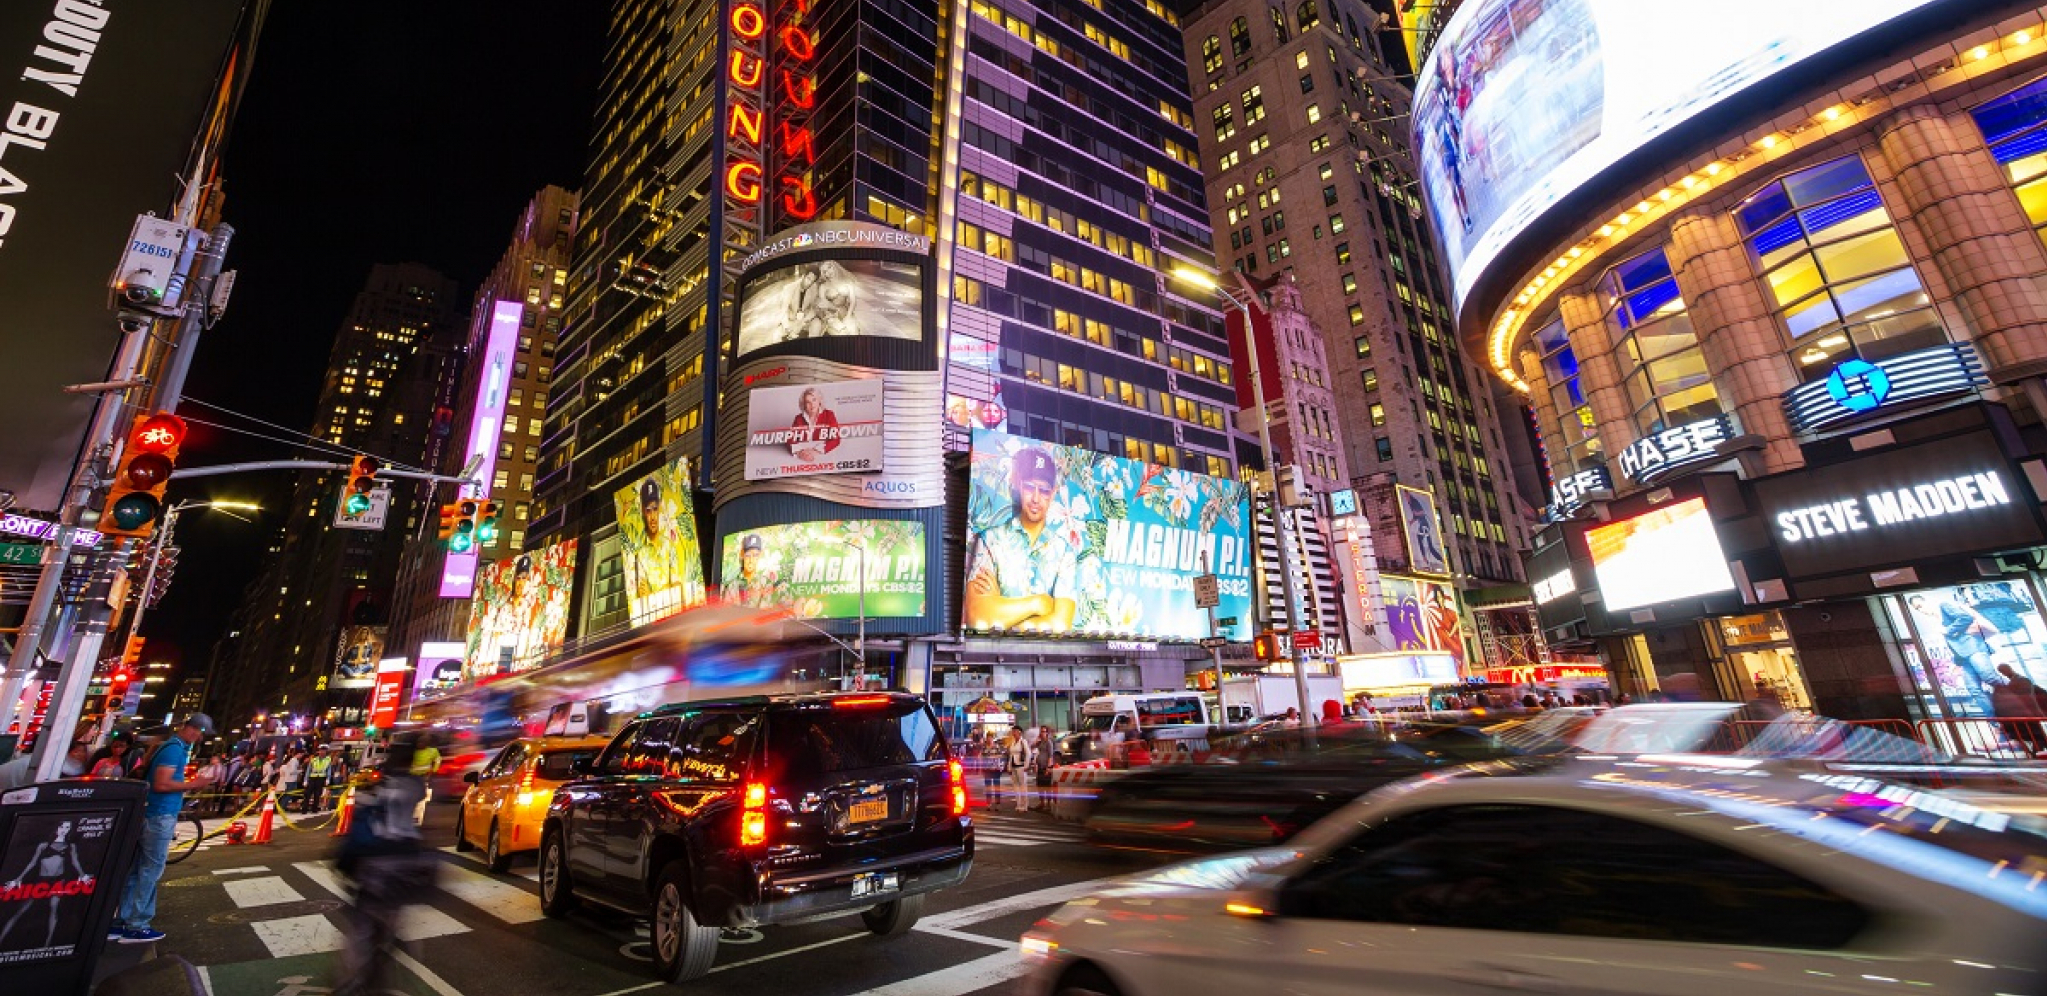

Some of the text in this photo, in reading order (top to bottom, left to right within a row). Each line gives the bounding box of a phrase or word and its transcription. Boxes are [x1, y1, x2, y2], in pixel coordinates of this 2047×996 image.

[132, 240, 173, 259] 726151
[815, 230, 930, 250] NBCUNIVERSAL
[750, 428, 814, 447] MURPHY
[818, 424, 879, 441] BROWN
[1618, 417, 1727, 479] CHASE
[755, 467, 779, 476] NEW
[780, 462, 835, 474] THURSDAYS
[864, 481, 916, 493] AQUOS
[1778, 470, 2010, 542] STEVE MADDEN
[3, 546, 25, 561] 42
[1103, 517, 1250, 577] MAGNUM P.I.
[792, 554, 924, 583] MAGNUM P.I.
[1102, 566, 1137, 587] NEW
[1346, 517, 1377, 636] AMSTERDAM
[791, 584, 818, 595] NEW
